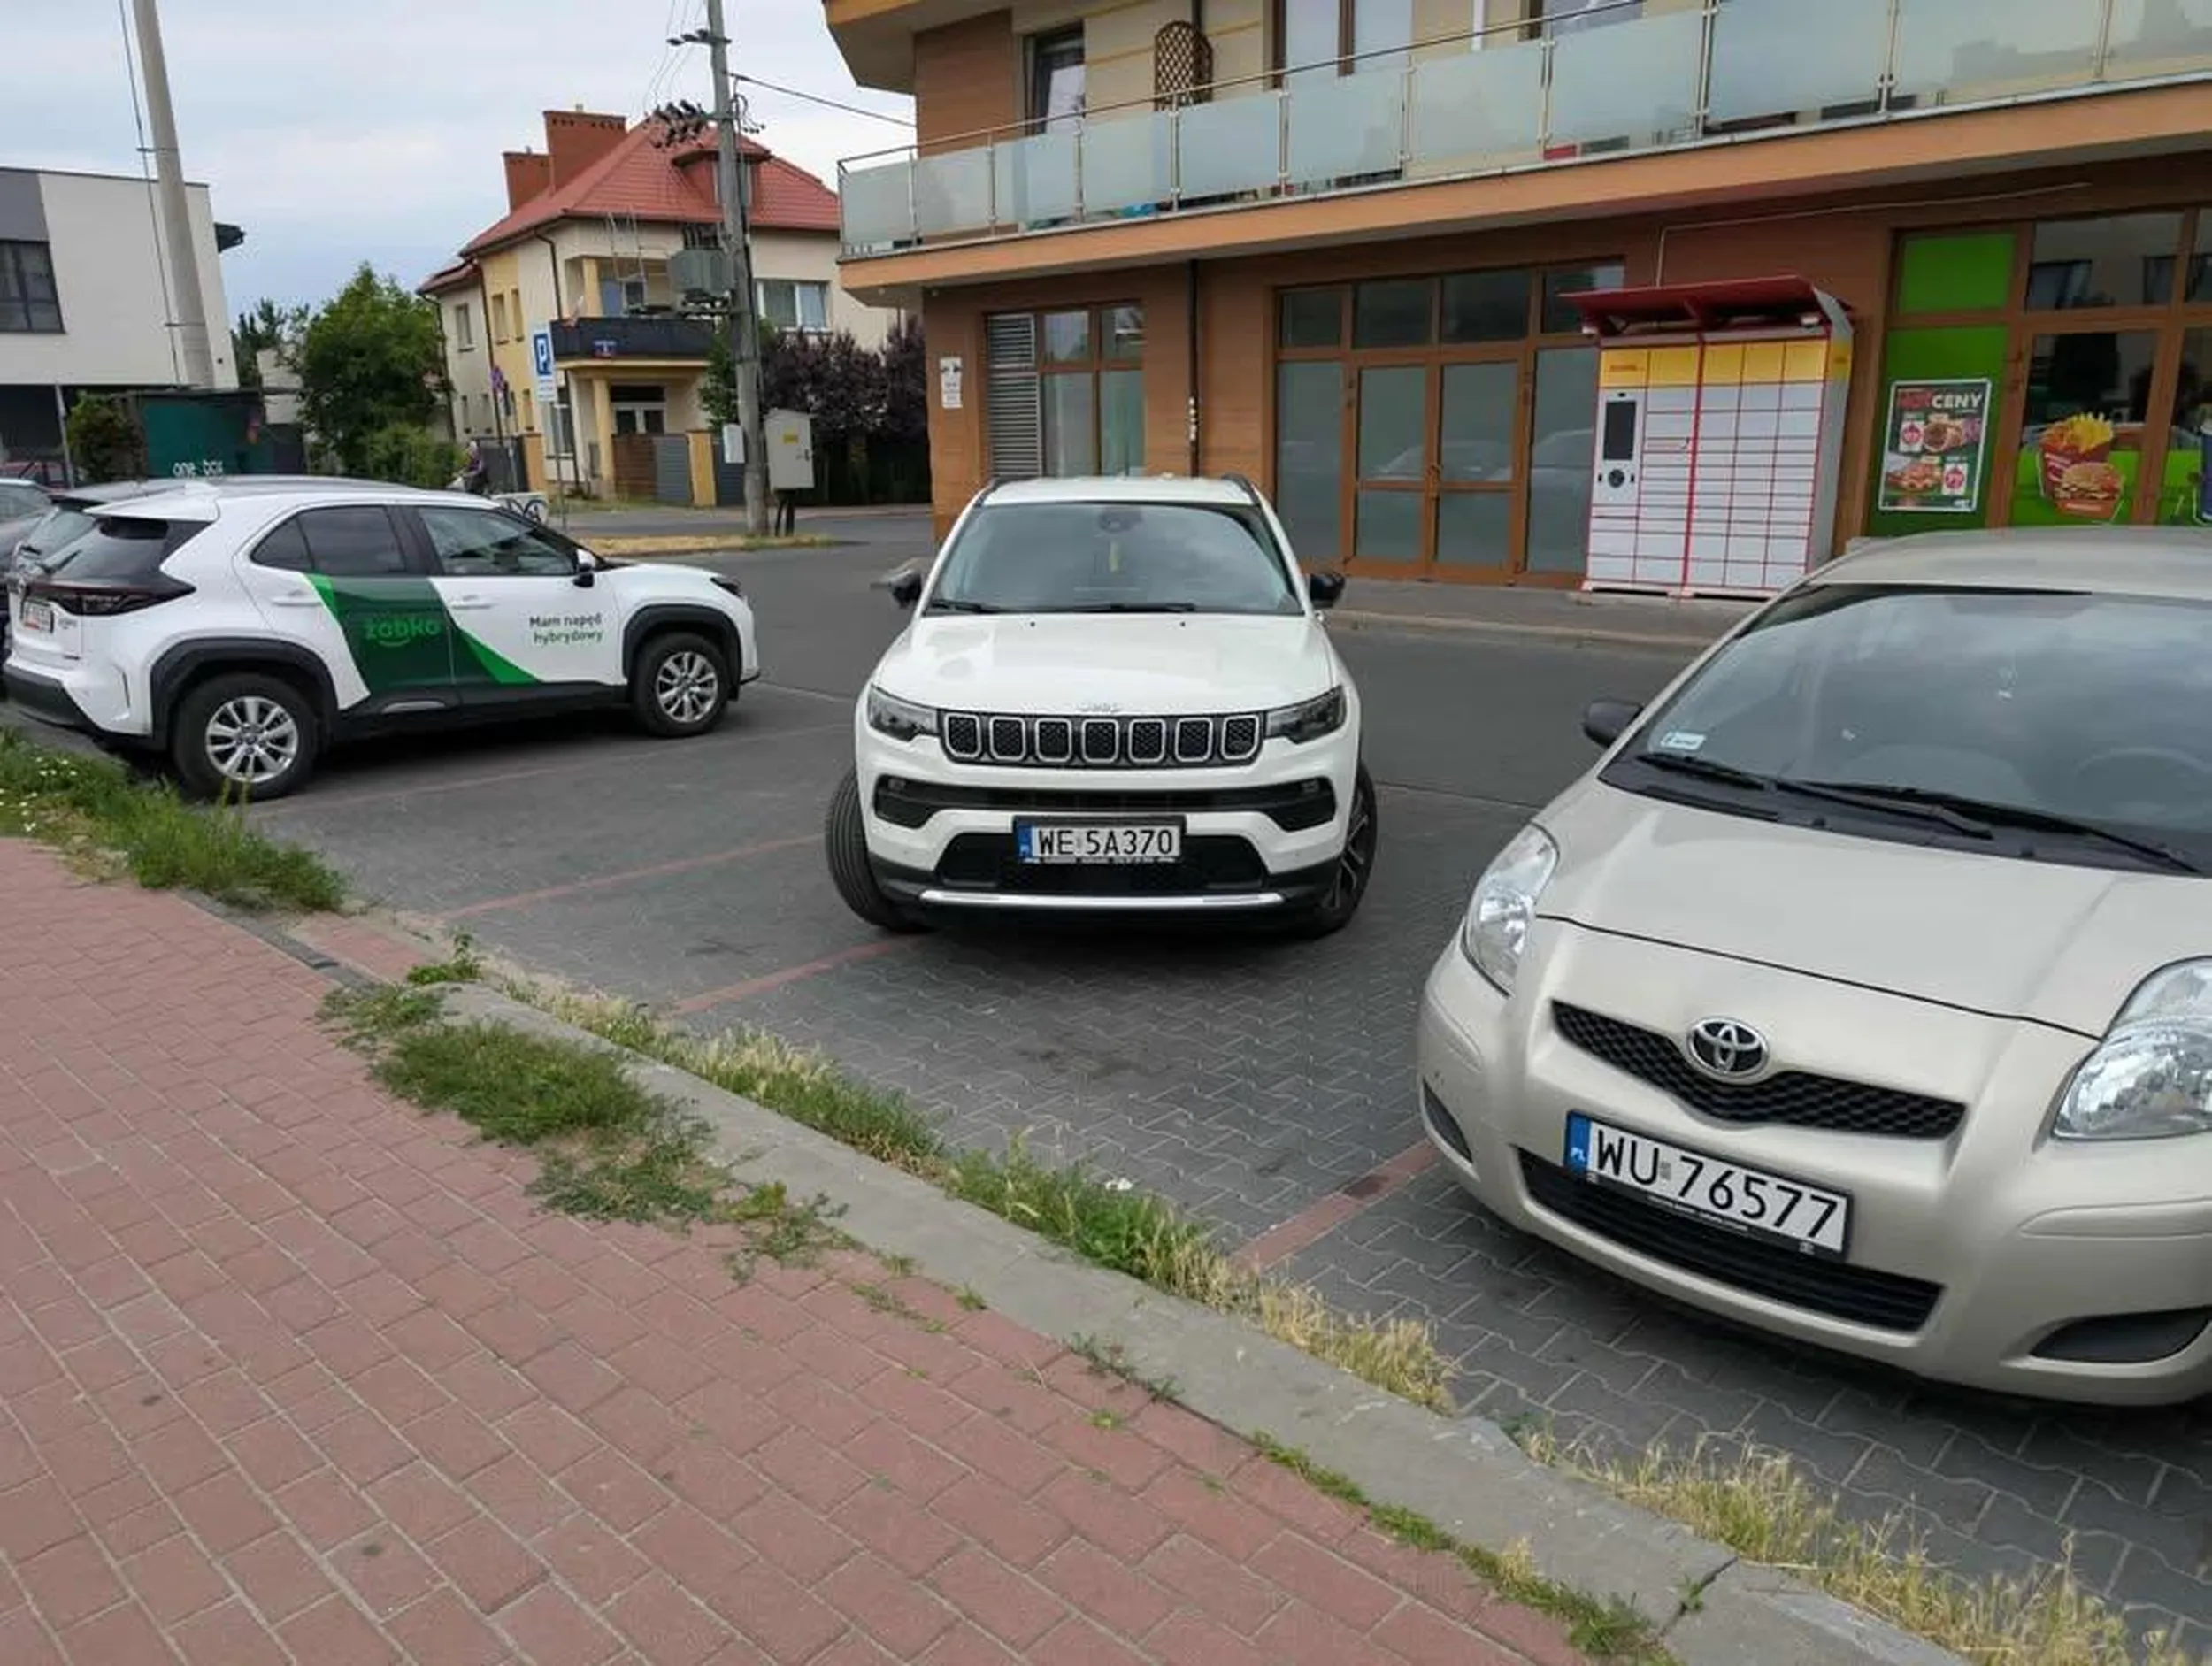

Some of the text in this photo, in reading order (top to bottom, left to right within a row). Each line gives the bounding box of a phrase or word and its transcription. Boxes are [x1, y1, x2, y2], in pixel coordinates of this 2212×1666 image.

[536, 338, 548, 371] P
[1932, 392, 1983, 409] CENY
[529, 615, 561, 628] Mam
[1038, 829, 1074, 856] WE
[1086, 829, 1173, 856] 5A370
[1597, 1129, 1660, 1186] WU
[1678, 1155, 1839, 1239] 76577
